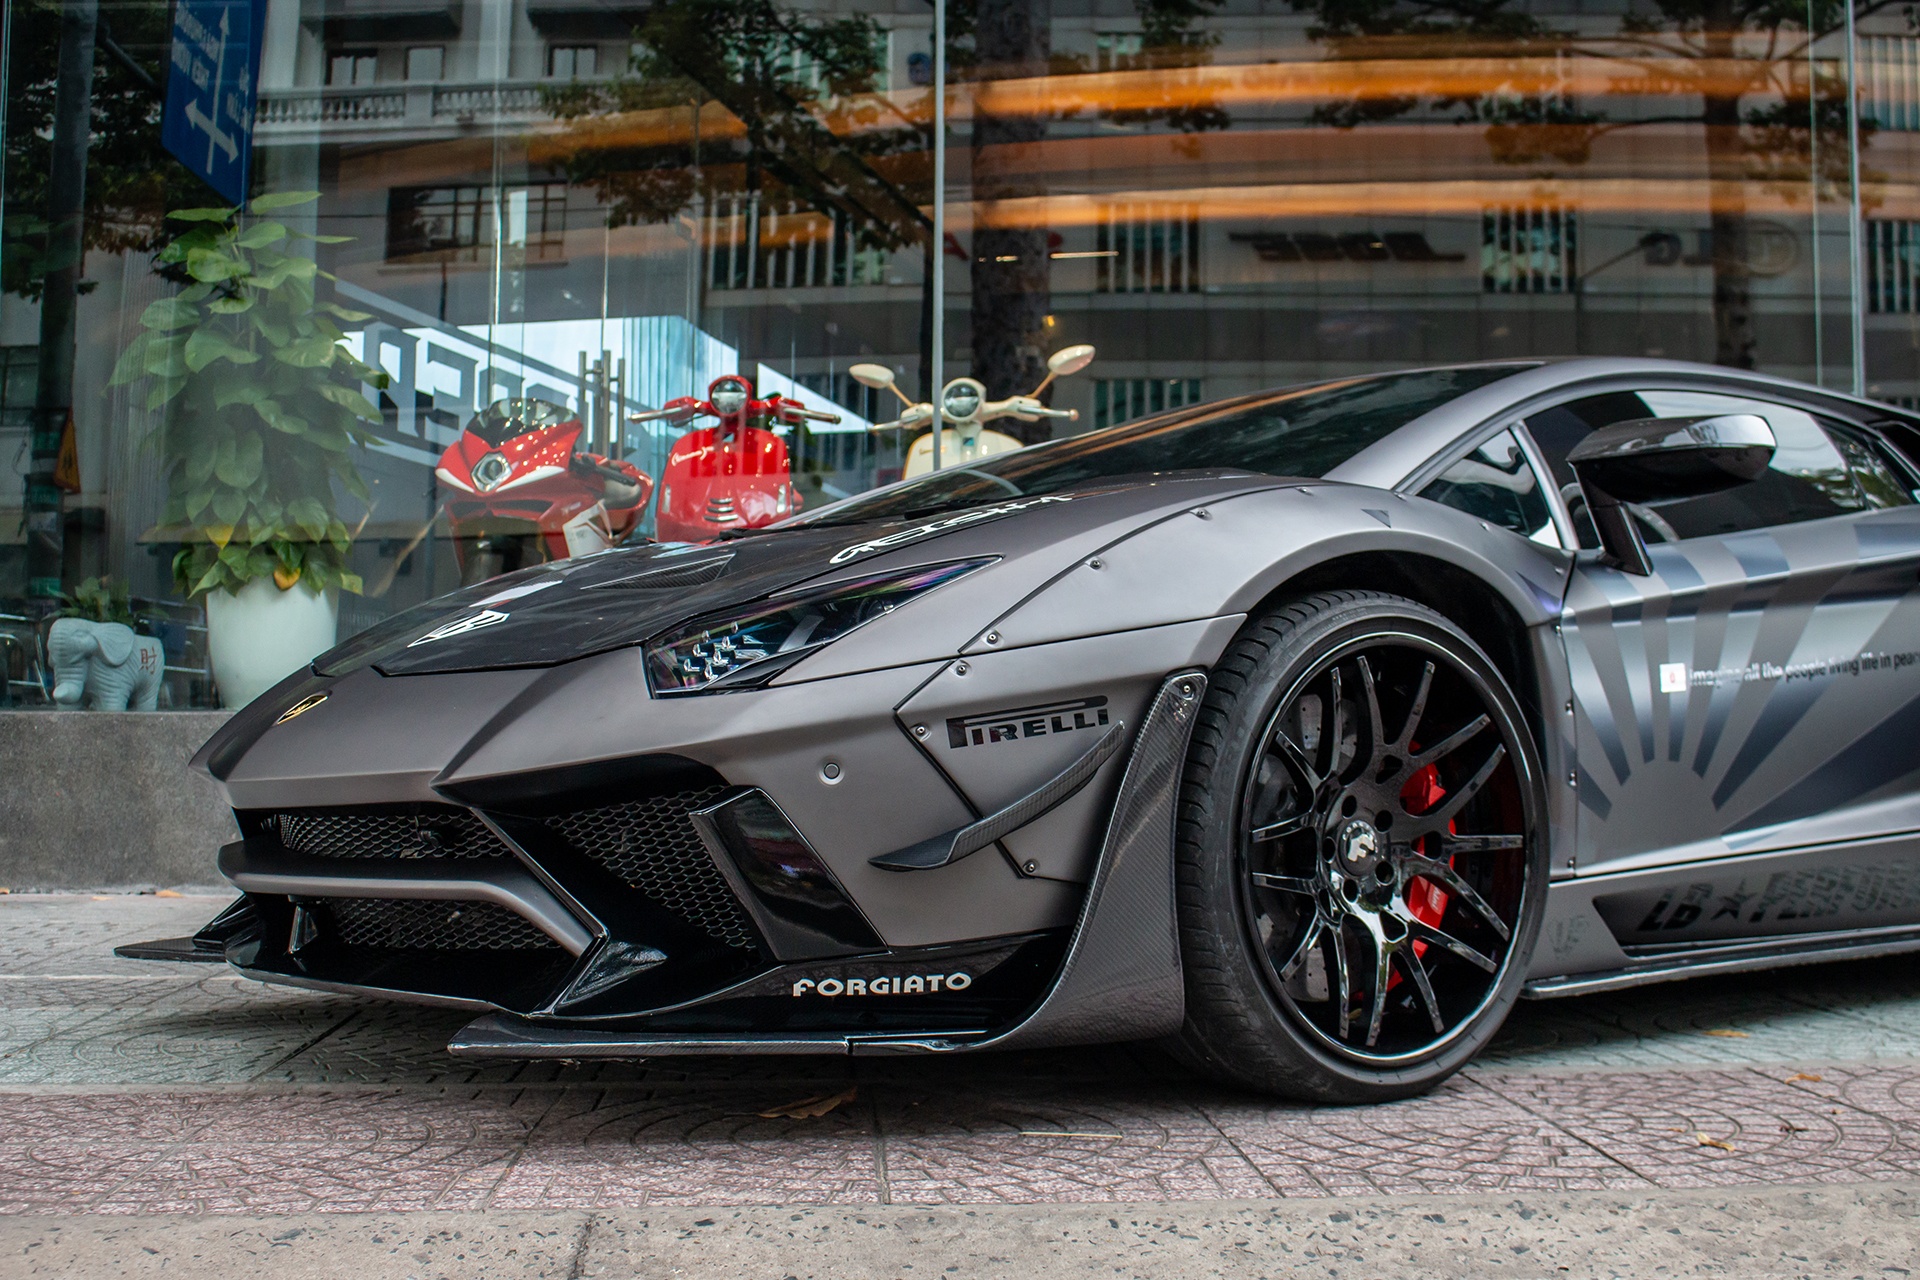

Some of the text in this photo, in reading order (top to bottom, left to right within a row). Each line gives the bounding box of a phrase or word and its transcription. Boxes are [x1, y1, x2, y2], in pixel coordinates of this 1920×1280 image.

[1762, 661, 1783, 679] the
[1785, 660, 1826, 682] people
[946, 695, 1109, 749] PIRELLI
[793, 972, 972, 997] FORGIATO
